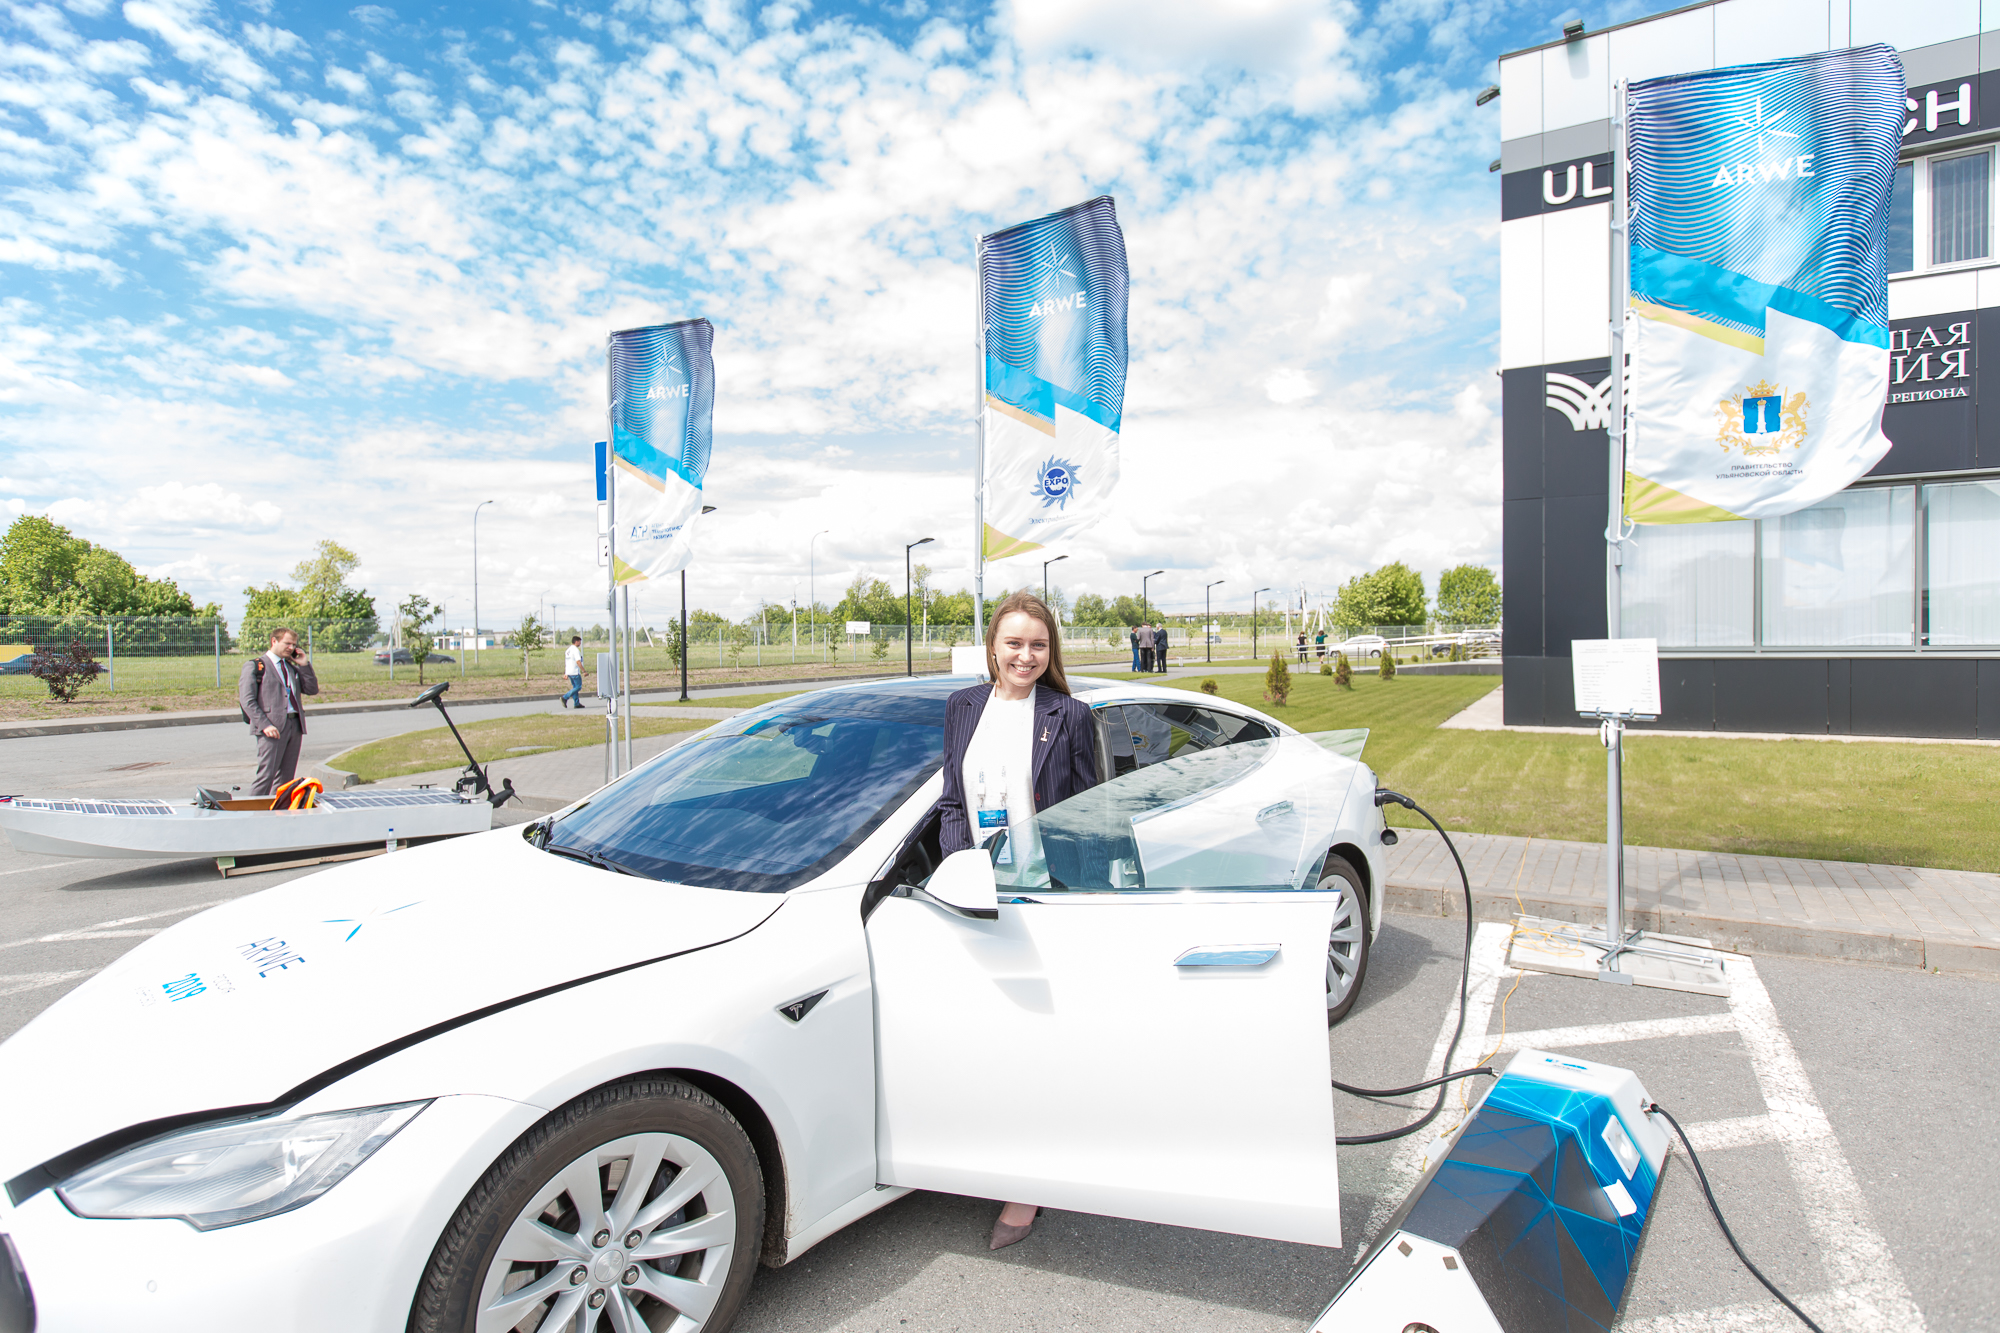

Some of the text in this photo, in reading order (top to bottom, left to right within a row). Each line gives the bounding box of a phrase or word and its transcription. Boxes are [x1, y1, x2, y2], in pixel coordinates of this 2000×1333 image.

[1711, 153, 1815, 188] ARWE
[1029, 290, 1087, 318] ARWE
[646, 383, 689, 400] ARWE
[1892, 387, 1967, 403] РЕГИОНА
[1716, 470, 1771, 479] УЛЬЯНОВСКОЙ
[1731, 462, 1793, 471] ПРАВИТЕЛЬСТВО
[1044, 477, 1068, 487] EXPO
[236, 936, 306, 979] ARWE
[162, 972, 207, 1002] 2019
